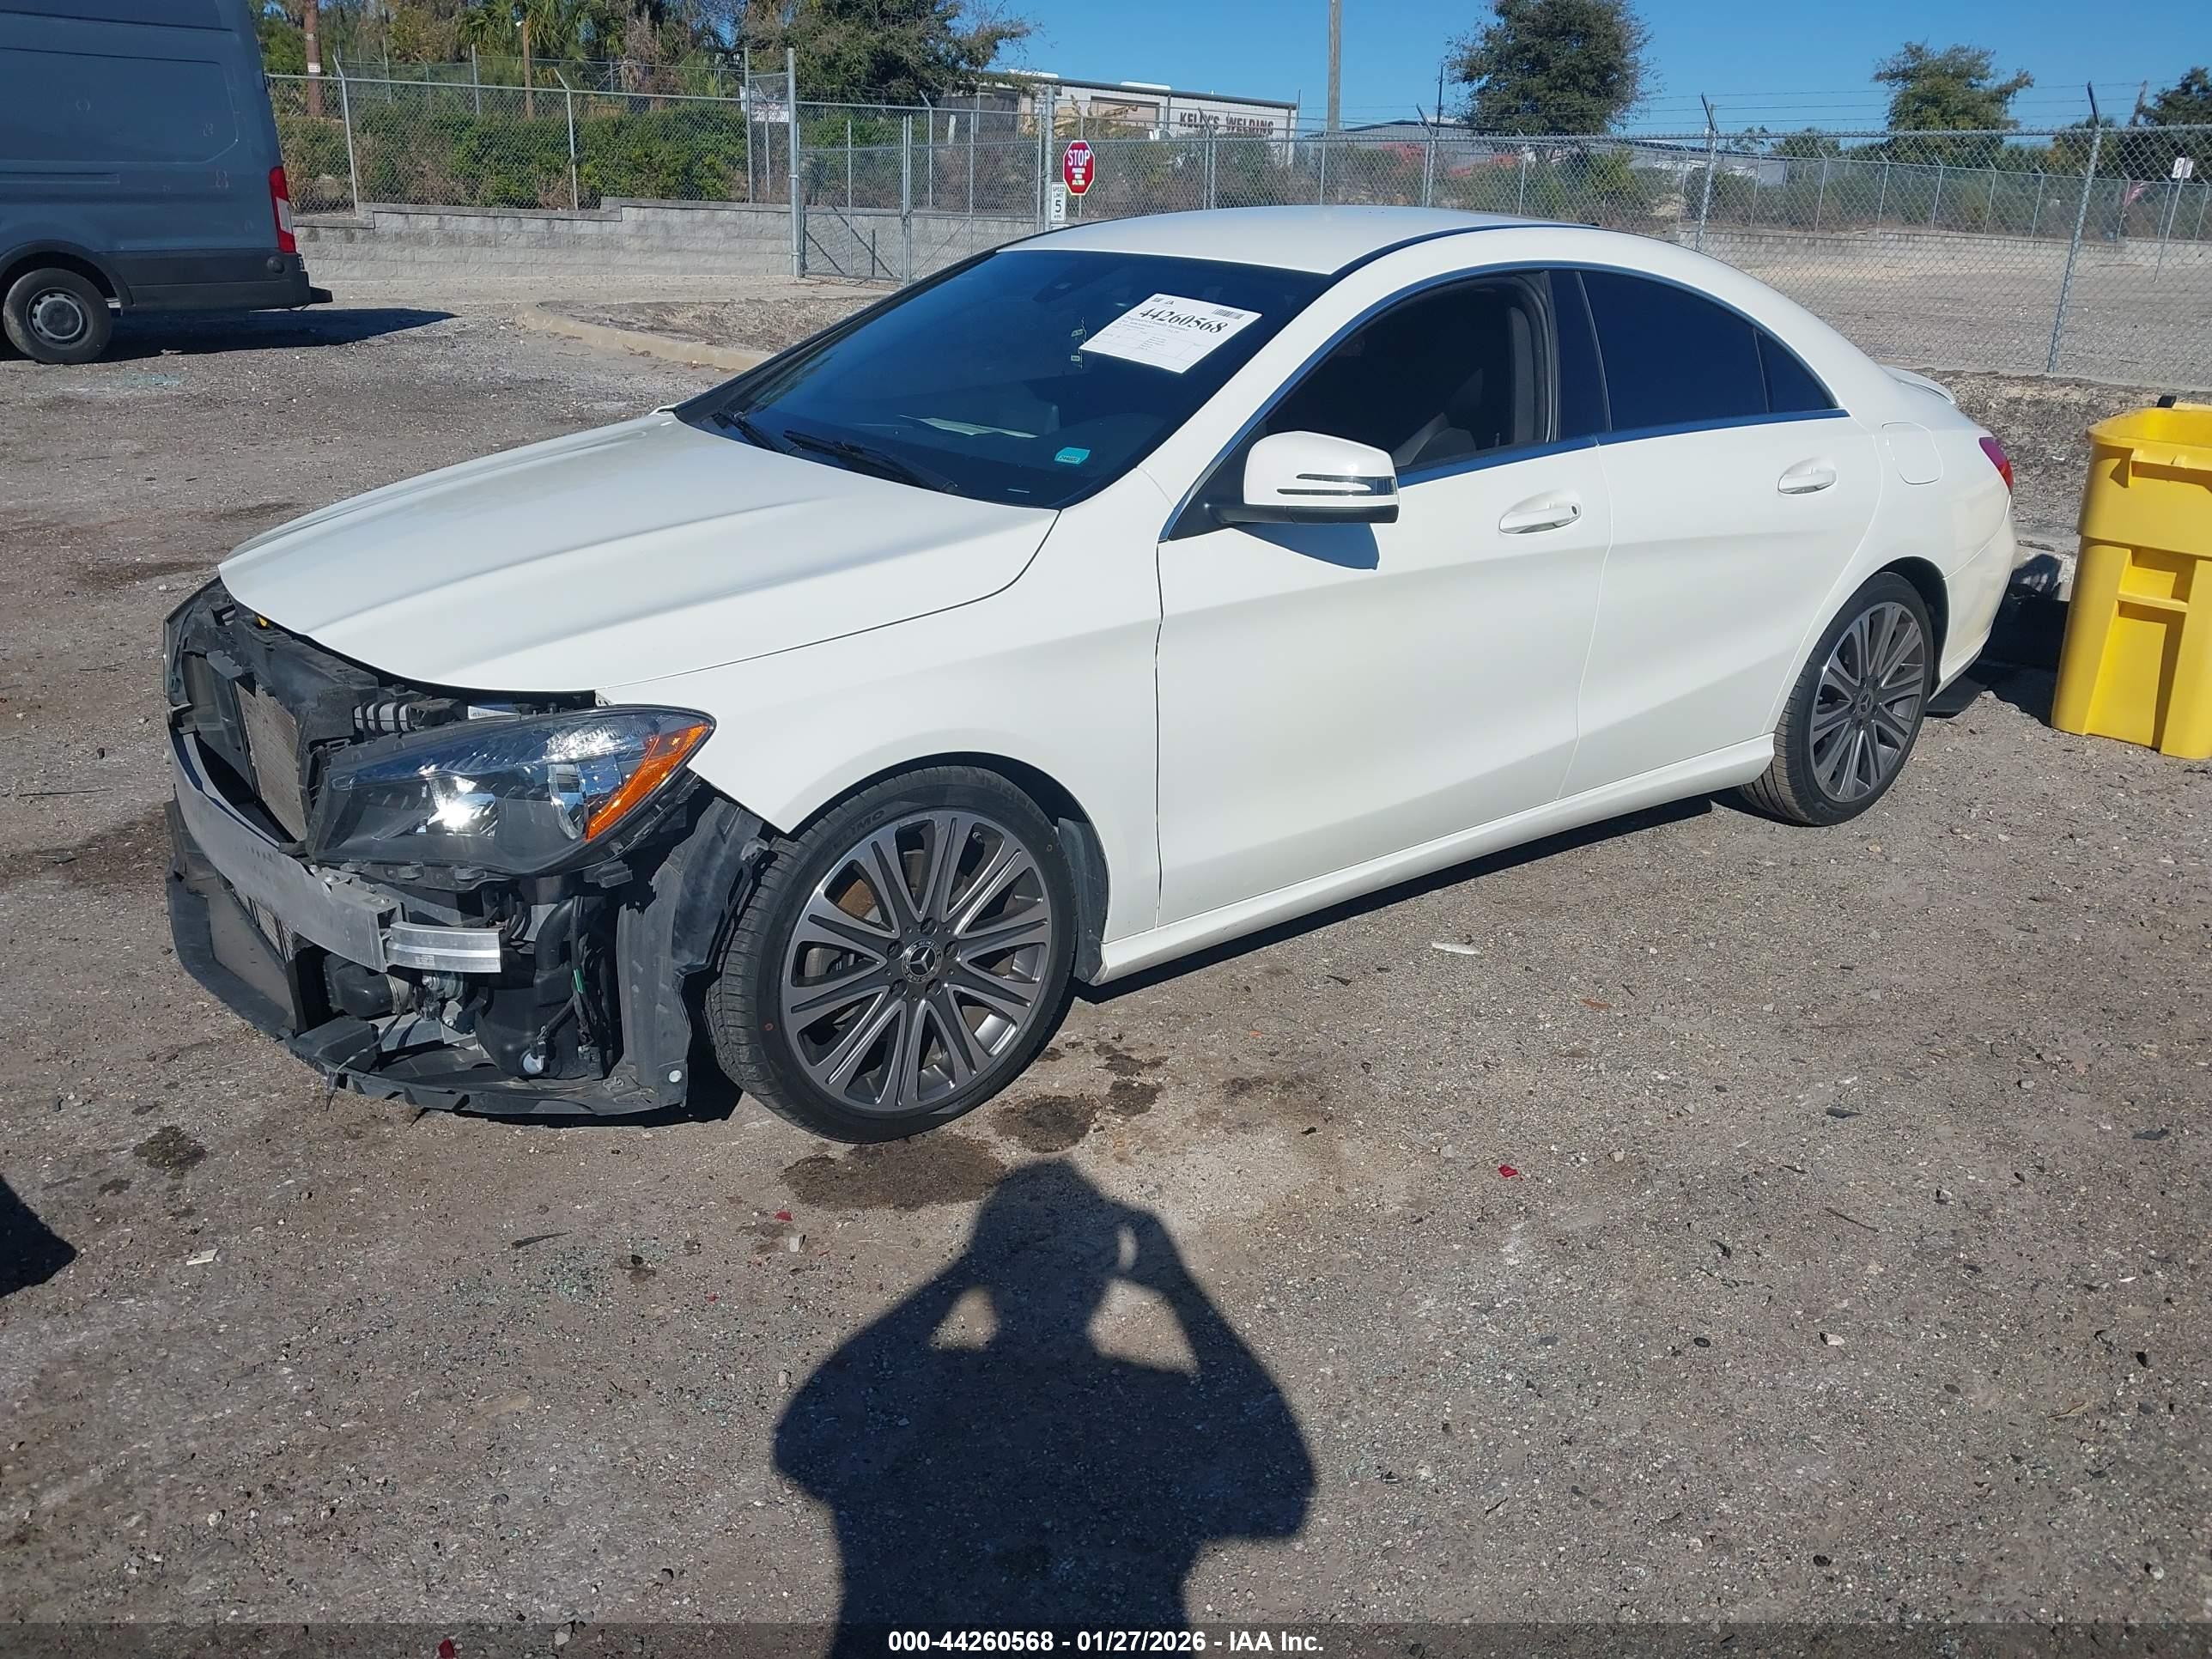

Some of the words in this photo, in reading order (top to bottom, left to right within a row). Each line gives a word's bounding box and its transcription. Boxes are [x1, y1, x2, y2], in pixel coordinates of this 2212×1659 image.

[1179, 112, 1220, 131] KELLY'S
[1226, 116, 1273, 136] WELDING
[1067, 149, 1091, 166] STOP
[1054, 199, 1062, 213] 5
[1139, 307, 1229, 334] 44260568
